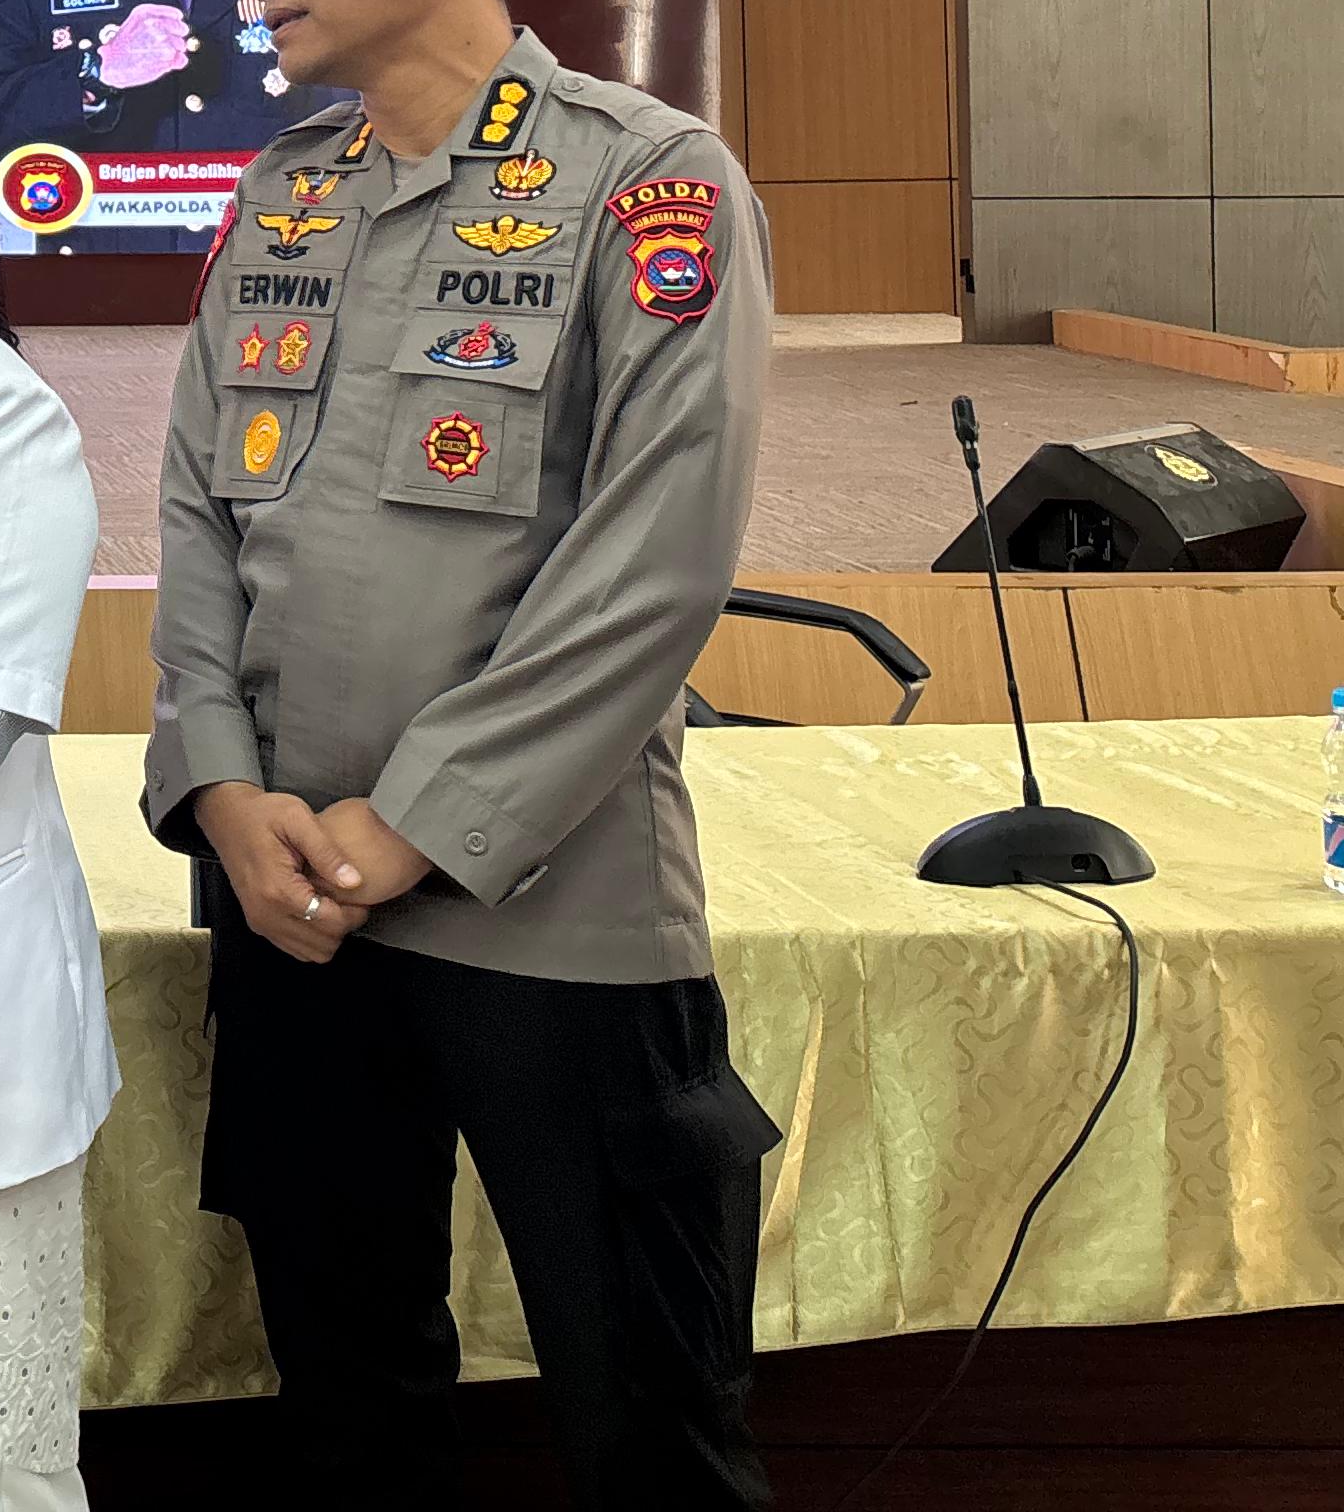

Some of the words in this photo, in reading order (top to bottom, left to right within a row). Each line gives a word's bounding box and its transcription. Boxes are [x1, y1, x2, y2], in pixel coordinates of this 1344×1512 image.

[98, 164, 156, 183] Brigjen
[98, 200, 212, 214] WAKAPOLDA
[619, 183, 709, 212] POLDA
[630, 211, 675, 230] SUMATERA
[677, 212, 705, 226] BARAT
[239, 273, 332, 308] ERWIN
[437, 269, 555, 308] POLRI
